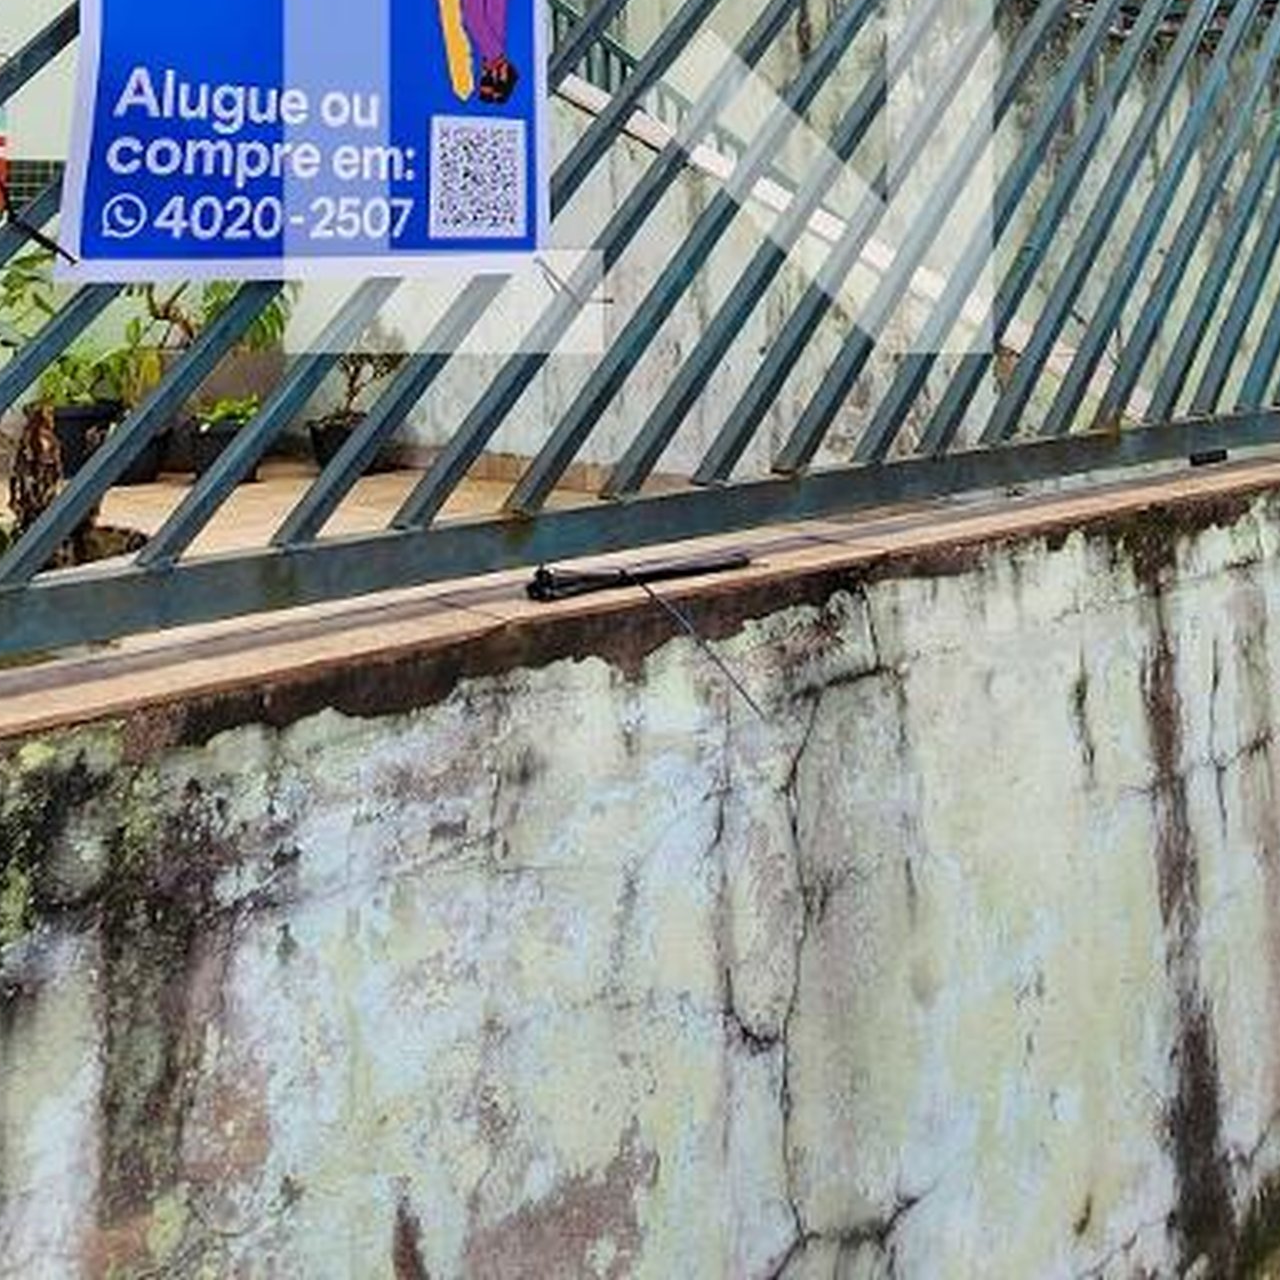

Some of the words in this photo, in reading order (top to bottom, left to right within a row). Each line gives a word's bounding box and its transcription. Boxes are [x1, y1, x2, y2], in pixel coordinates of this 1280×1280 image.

[113, 66, 310, 133] Alugue
[320, 90, 381, 128] ou
[106, 137, 320, 187] compre
[331, 146, 416, 182] em:
